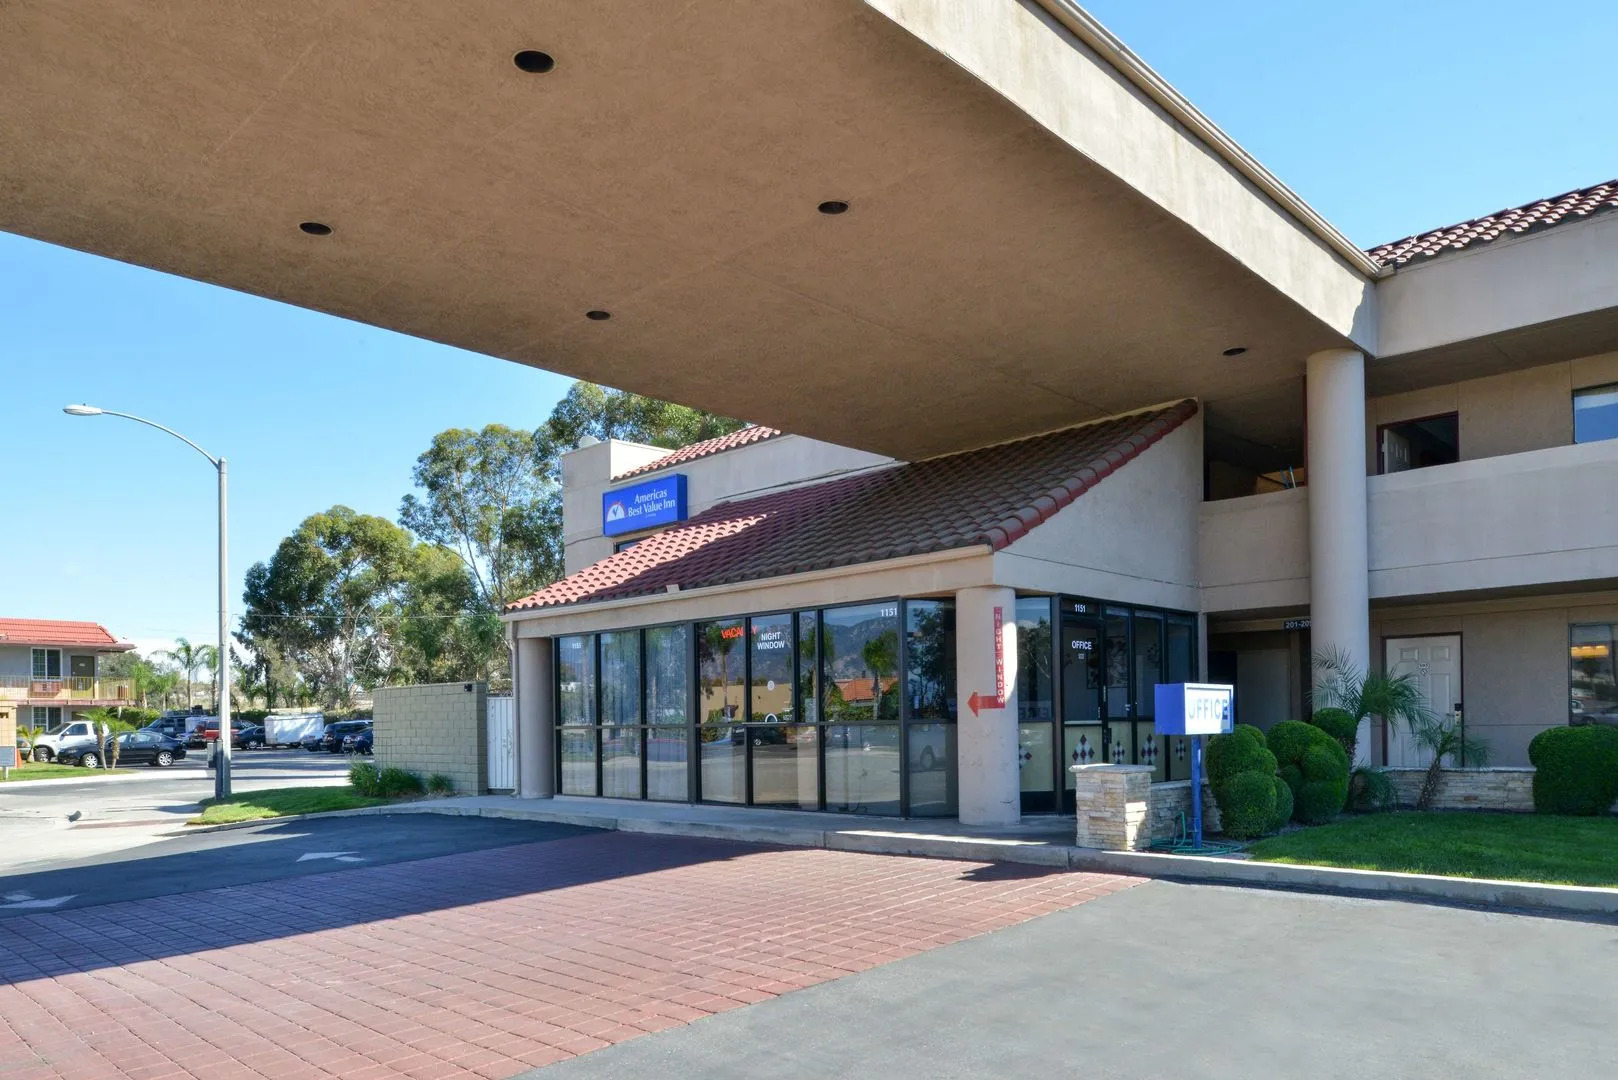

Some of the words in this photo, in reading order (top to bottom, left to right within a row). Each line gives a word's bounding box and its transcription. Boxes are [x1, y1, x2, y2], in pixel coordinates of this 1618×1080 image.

[634, 489, 668, 504] Americas
[628, 506, 643, 517] Best
[644, 500, 663, 513] Value
[664, 499, 676, 508] Inn
[881, 607, 898, 617] 1151
[1074, 604, 1086, 612] 1151
[761, 632, 781, 641] NIGHT
[757, 640, 785, 650] WINDOW
[1071, 640, 1092, 650] OFFICE
[996, 659, 1004, 704] WINDOW
[1188, 698, 1229, 720] OFFICE
